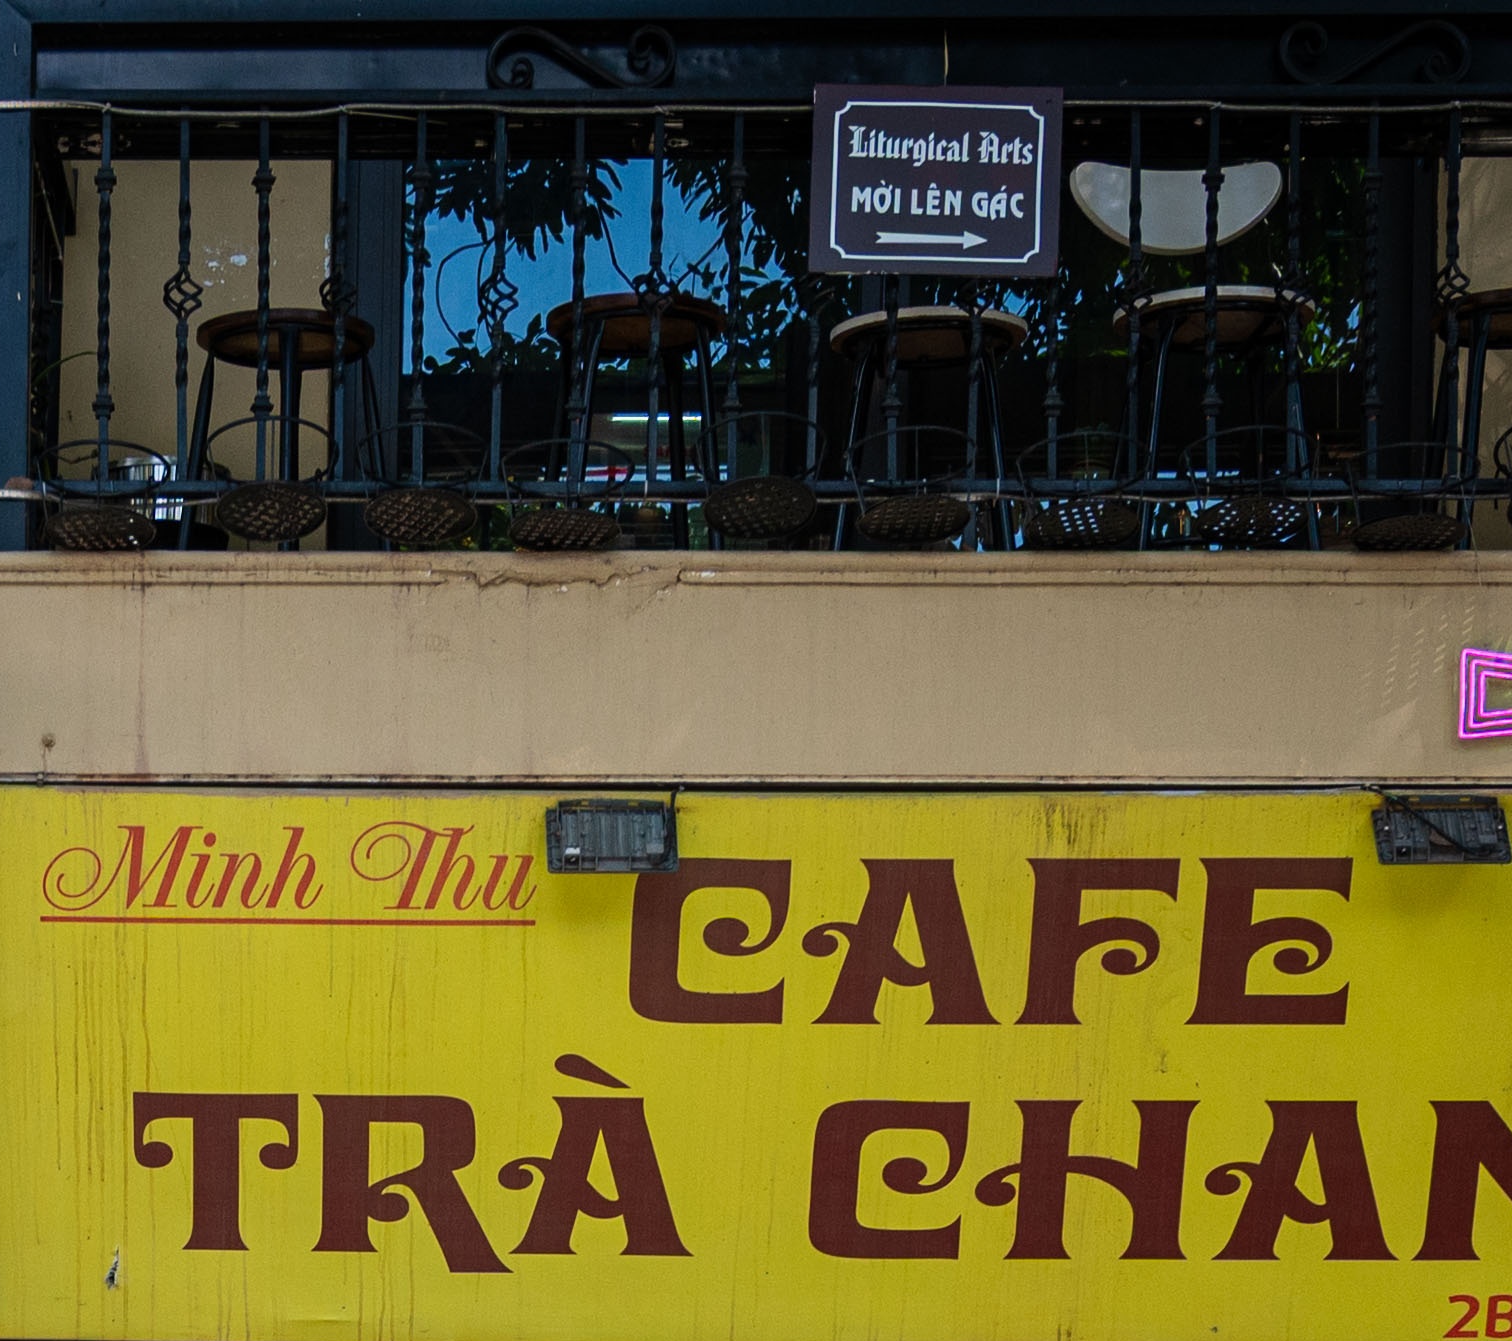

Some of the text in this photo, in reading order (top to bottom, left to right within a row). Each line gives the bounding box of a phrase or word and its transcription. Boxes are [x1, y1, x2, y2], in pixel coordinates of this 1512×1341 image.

[848, 126, 1034, 167] Liturgical Arts
[851, 180, 1025, 221] MỜI LÊN GÁC
[41, 821, 536, 912] Minh Thu
[628, 857, 1353, 1026] CAFE
[132, 1053, 694, 1273] TRÀ
